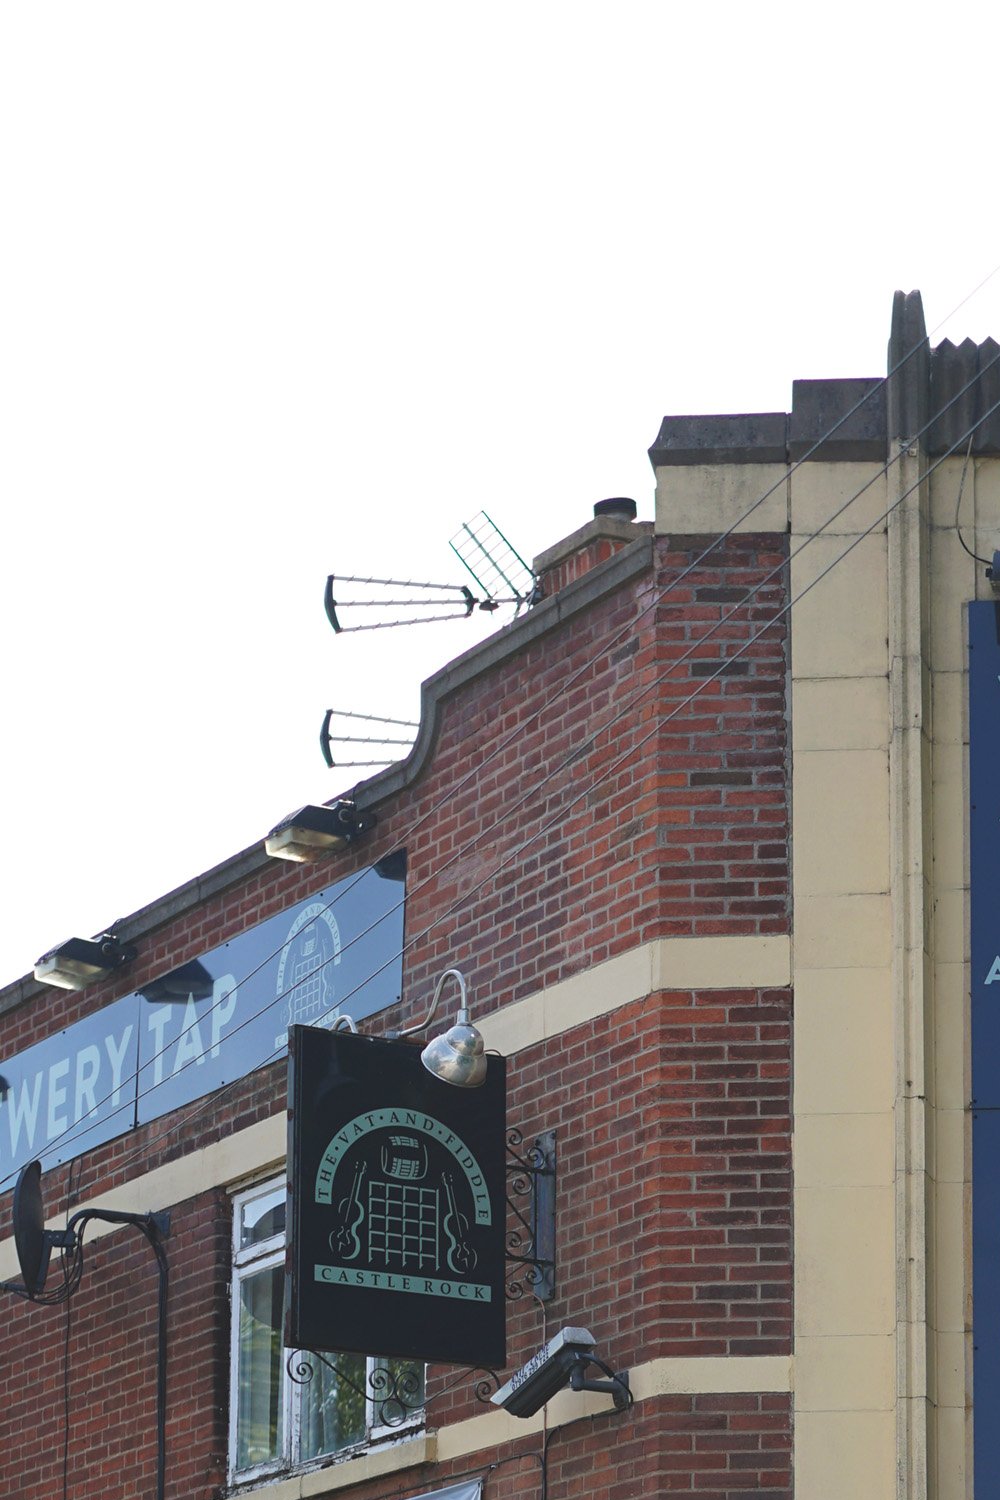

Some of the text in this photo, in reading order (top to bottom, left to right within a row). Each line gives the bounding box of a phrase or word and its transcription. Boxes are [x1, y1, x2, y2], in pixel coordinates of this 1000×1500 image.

[0, 974, 238, 1159] WERY TAP
[318, 1111, 489, 1219] THE VAT AND FIDDLE
[321, 1267, 485, 1299] CASTLE ROCK
